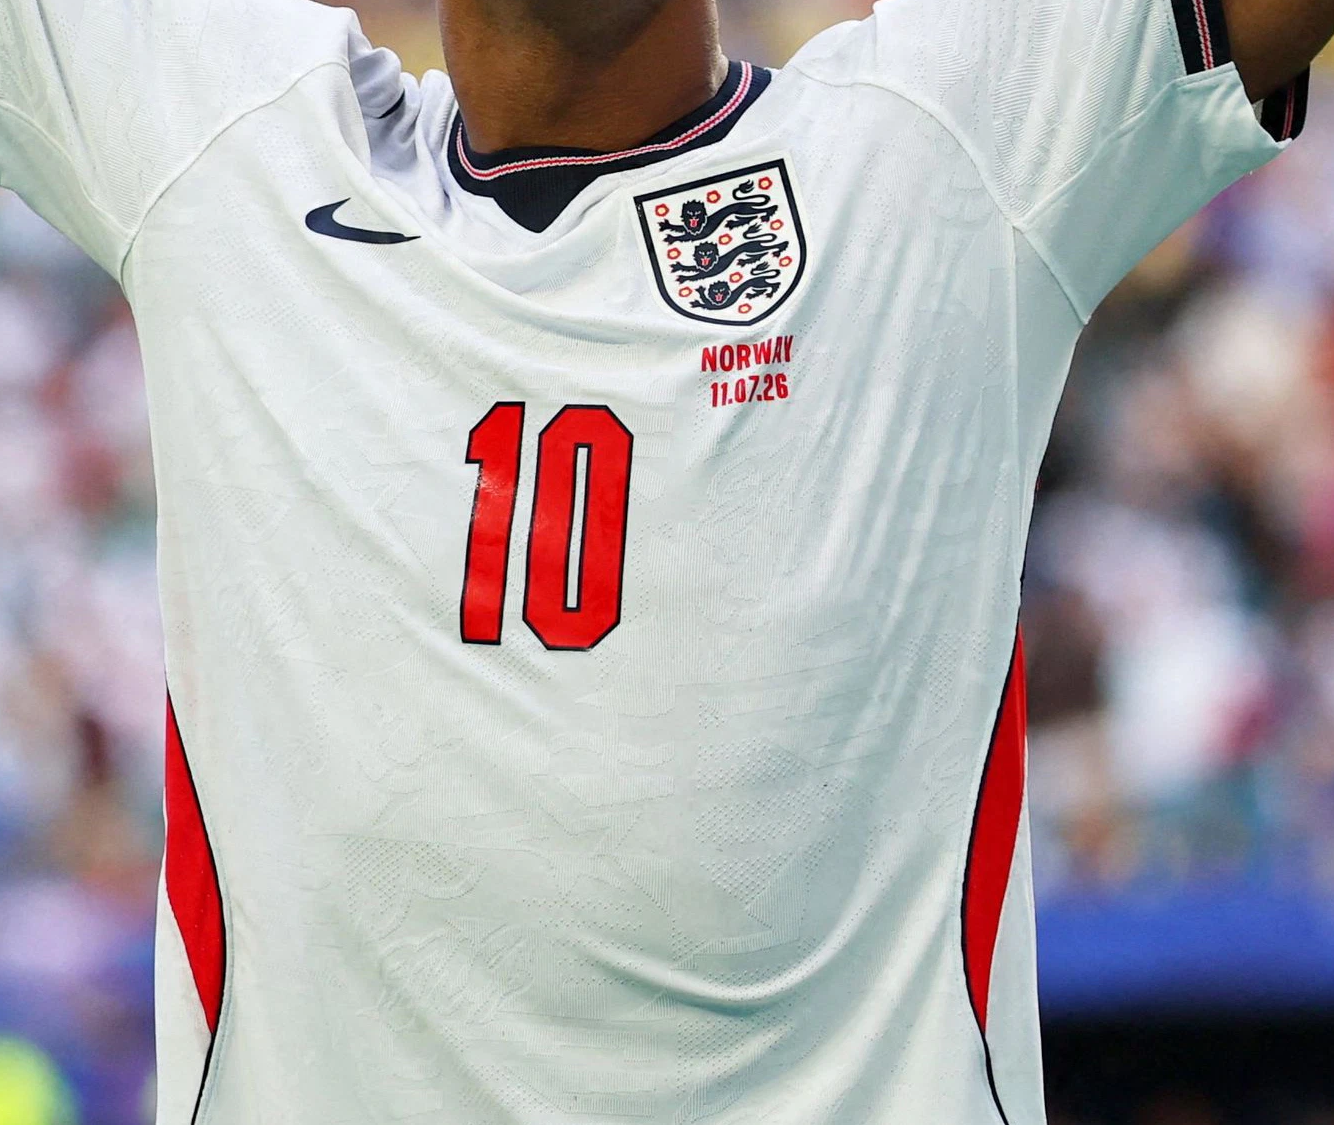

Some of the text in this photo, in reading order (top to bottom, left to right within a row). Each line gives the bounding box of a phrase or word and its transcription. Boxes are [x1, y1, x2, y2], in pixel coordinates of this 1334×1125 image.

[701, 335, 794, 372] NORWAY
[710, 372, 789, 408] 11.07.26
[460, 401, 634, 652] 10
